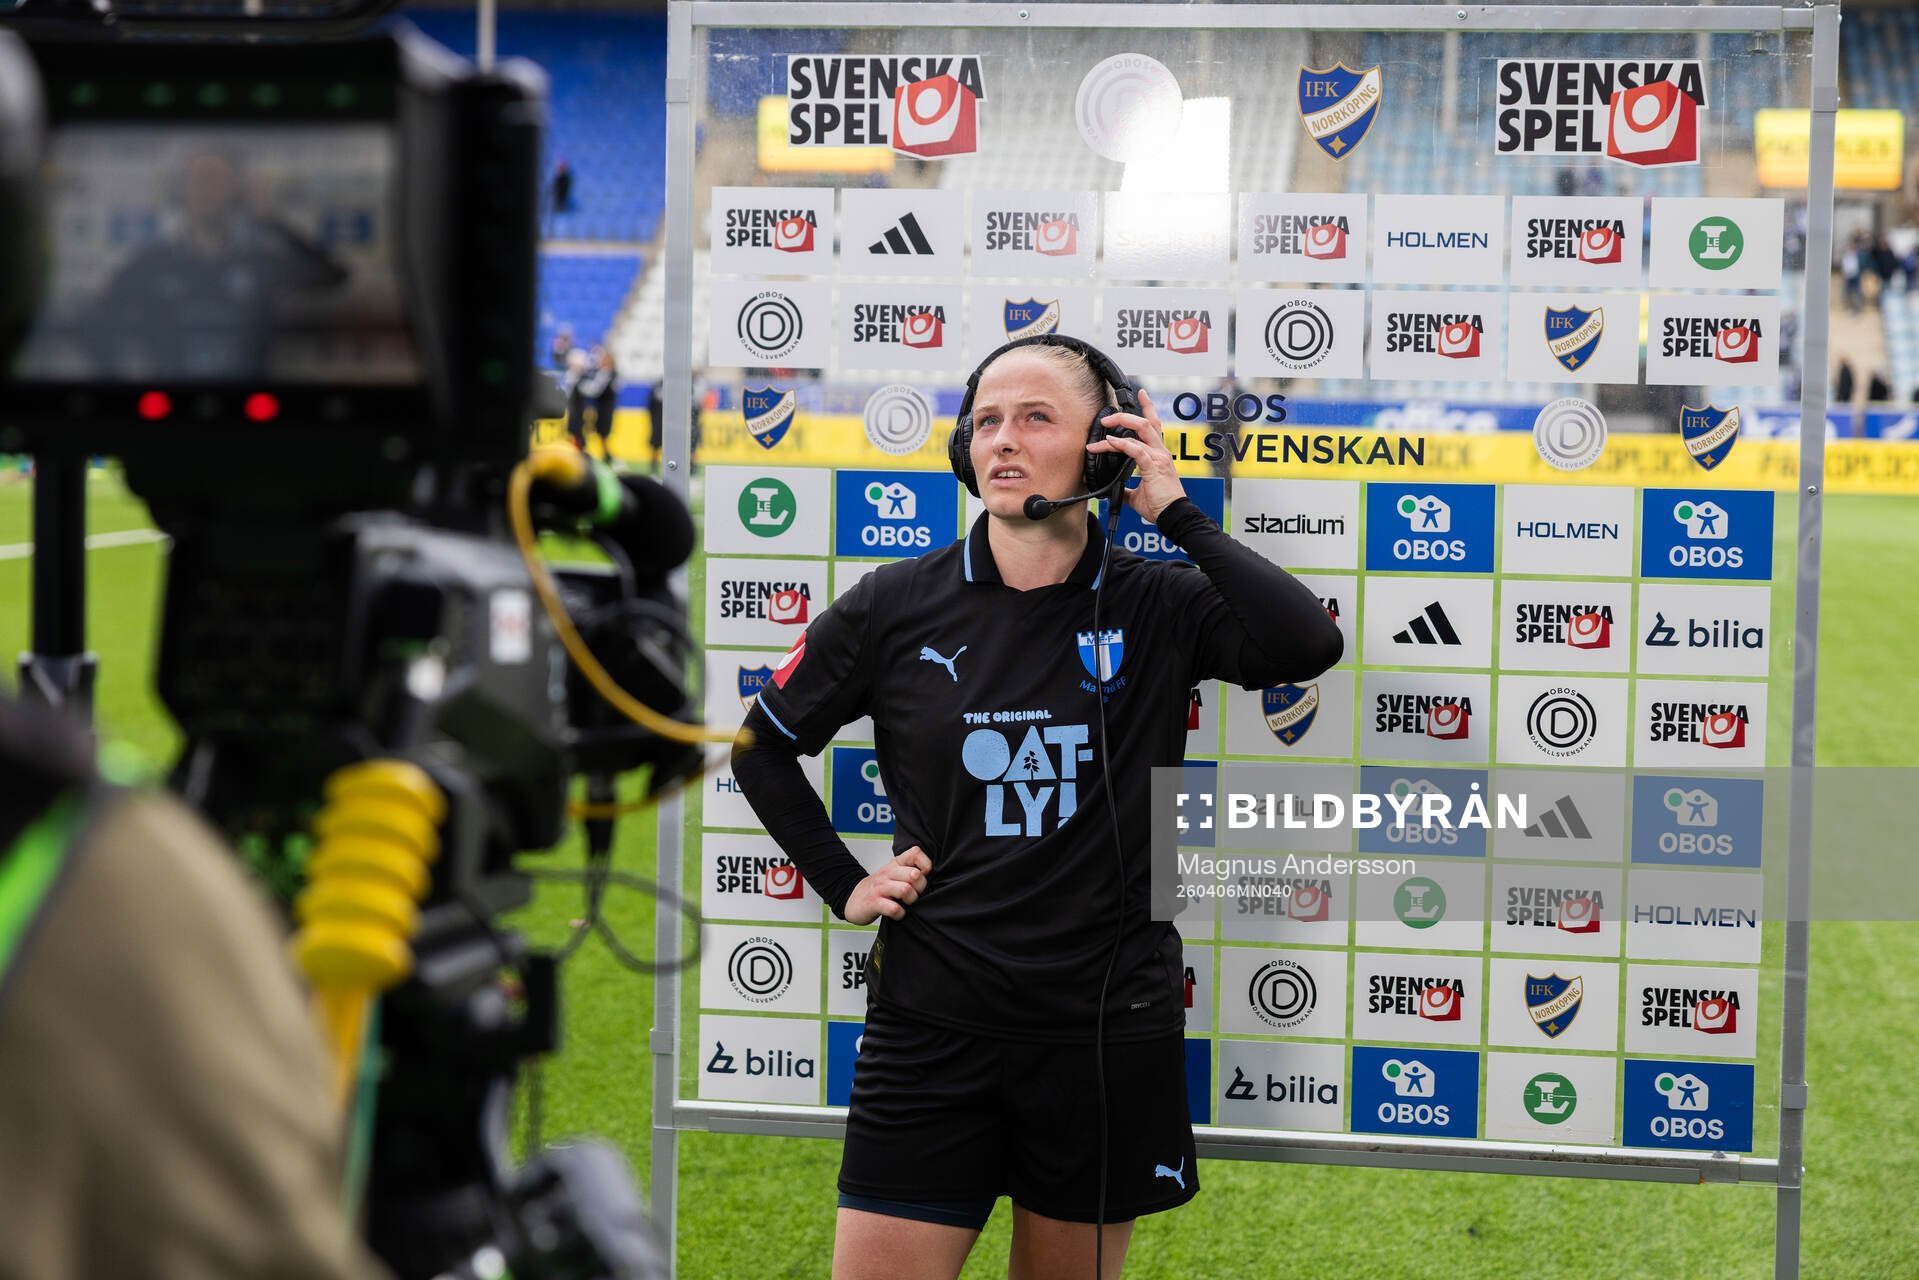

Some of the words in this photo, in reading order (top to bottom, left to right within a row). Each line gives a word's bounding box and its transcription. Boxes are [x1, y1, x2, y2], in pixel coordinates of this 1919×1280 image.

[790, 57, 984, 99] SVENSKA
[1499, 62, 1705, 106] SVENSKA
[1305, 81, 1340, 97] IFK
[790, 103, 888, 145] SPEL
[1498, 109, 1602, 152] SPEL
[726, 209, 818, 228] SVENSKA
[986, 211, 1080, 231] SVENSKA
[1253, 214, 1350, 234] SVENSKA
[1527, 218, 1625, 239] SVENSKA
[726, 229, 772, 247] SPEL
[986, 232, 1034, 250] SPEL
[1253, 235, 1302, 254] SPEL
[1388, 232, 1488, 249] HOLMEN
[1526, 239, 1577, 258] SPEL
[758, 291, 784, 300] OBOS
[1287, 299, 1314, 309] OBOS
[853, 304, 946, 324] SVENSKA
[1009, 309, 1032, 321] IFK
[1117, 309, 1212, 329] SVENSKA
[1387, 312, 1484, 334] SVENSKA
[1550, 316, 1575, 329] IFK
[853, 324, 901, 343] SPEL
[1663, 317, 1762, 338] SVENSKA
[1117, 329, 1165, 348] SPEL
[1386, 333, 1436, 353] SPEL
[1662, 337, 1713, 357] SPEL
[740, 338, 800, 360] DAMALLSVENSKAN
[1267, 347, 1331, 370] DAMALLSVENSKAN
[746, 397, 769, 409] IFK
[1172, 391, 1287, 423] OBOS
[1686, 416, 1711, 428] IFK
[1244, 513, 1344, 535] stadium
[1517, 522, 1618, 540] HOLMEN
[861, 525, 931, 547] OBOS
[1393, 539, 1466, 562] OBOS
[1669, 545, 1743, 568] OBOS
[721, 580, 811, 600] SVENSKA
[720, 600, 767, 619] SPEL
[1516, 603, 1614, 624] SVENSKA
[1515, 624, 1566, 643] SPEL
[1688, 619, 1763, 649] bilia
[743, 675, 765, 686] IFK
[1267, 692, 1291, 705] IFK
[1549, 687, 1577, 697] OBOS
[1376, 693, 1472, 716] SVENSKA
[1650, 702, 1749, 724] SVENSKA
[962, 712, 990, 724] THE
[993, 709, 1052, 723] ORIGINAL
[1376, 713, 1426, 734] SPEL
[1650, 723, 1700, 743] SPEL
[1530, 734, 1594, 757] DAMALLSVENSKAN
[857, 802, 896, 824] OB
[1386, 822, 1458, 845] OBOS
[1658, 832, 1733, 855] OBOS
[716, 875, 763, 894] SPEL
[1237, 896, 1286, 916] SPEL
[1507, 886, 1604, 909] SVENSKA
[1506, 907, 1556, 927] SPEL
[1634, 904, 1756, 928] HOLMEN
[749, 936, 774, 946] OBOS
[1270, 959, 1298, 969] OBOS
[730, 982, 789, 1003] DAMALLSVENSKAN
[1369, 975, 1465, 998] SVENSKA
[1530, 984, 1554, 996] IFK
[1368, 995, 1418, 1015] SPEL
[1642, 987, 1740, 1010] SVENSKA
[1252, 1006, 1313, 1028] DAMALLSVENSKAN
[1641, 1008, 1692, 1028] SPEL
[746, 1048, 814, 1078] bilia
[1266, 1074, 1338, 1105] bilia
[1378, 1102, 1450, 1126] OBOS
[1650, 1116, 1724, 1140] OBOS
